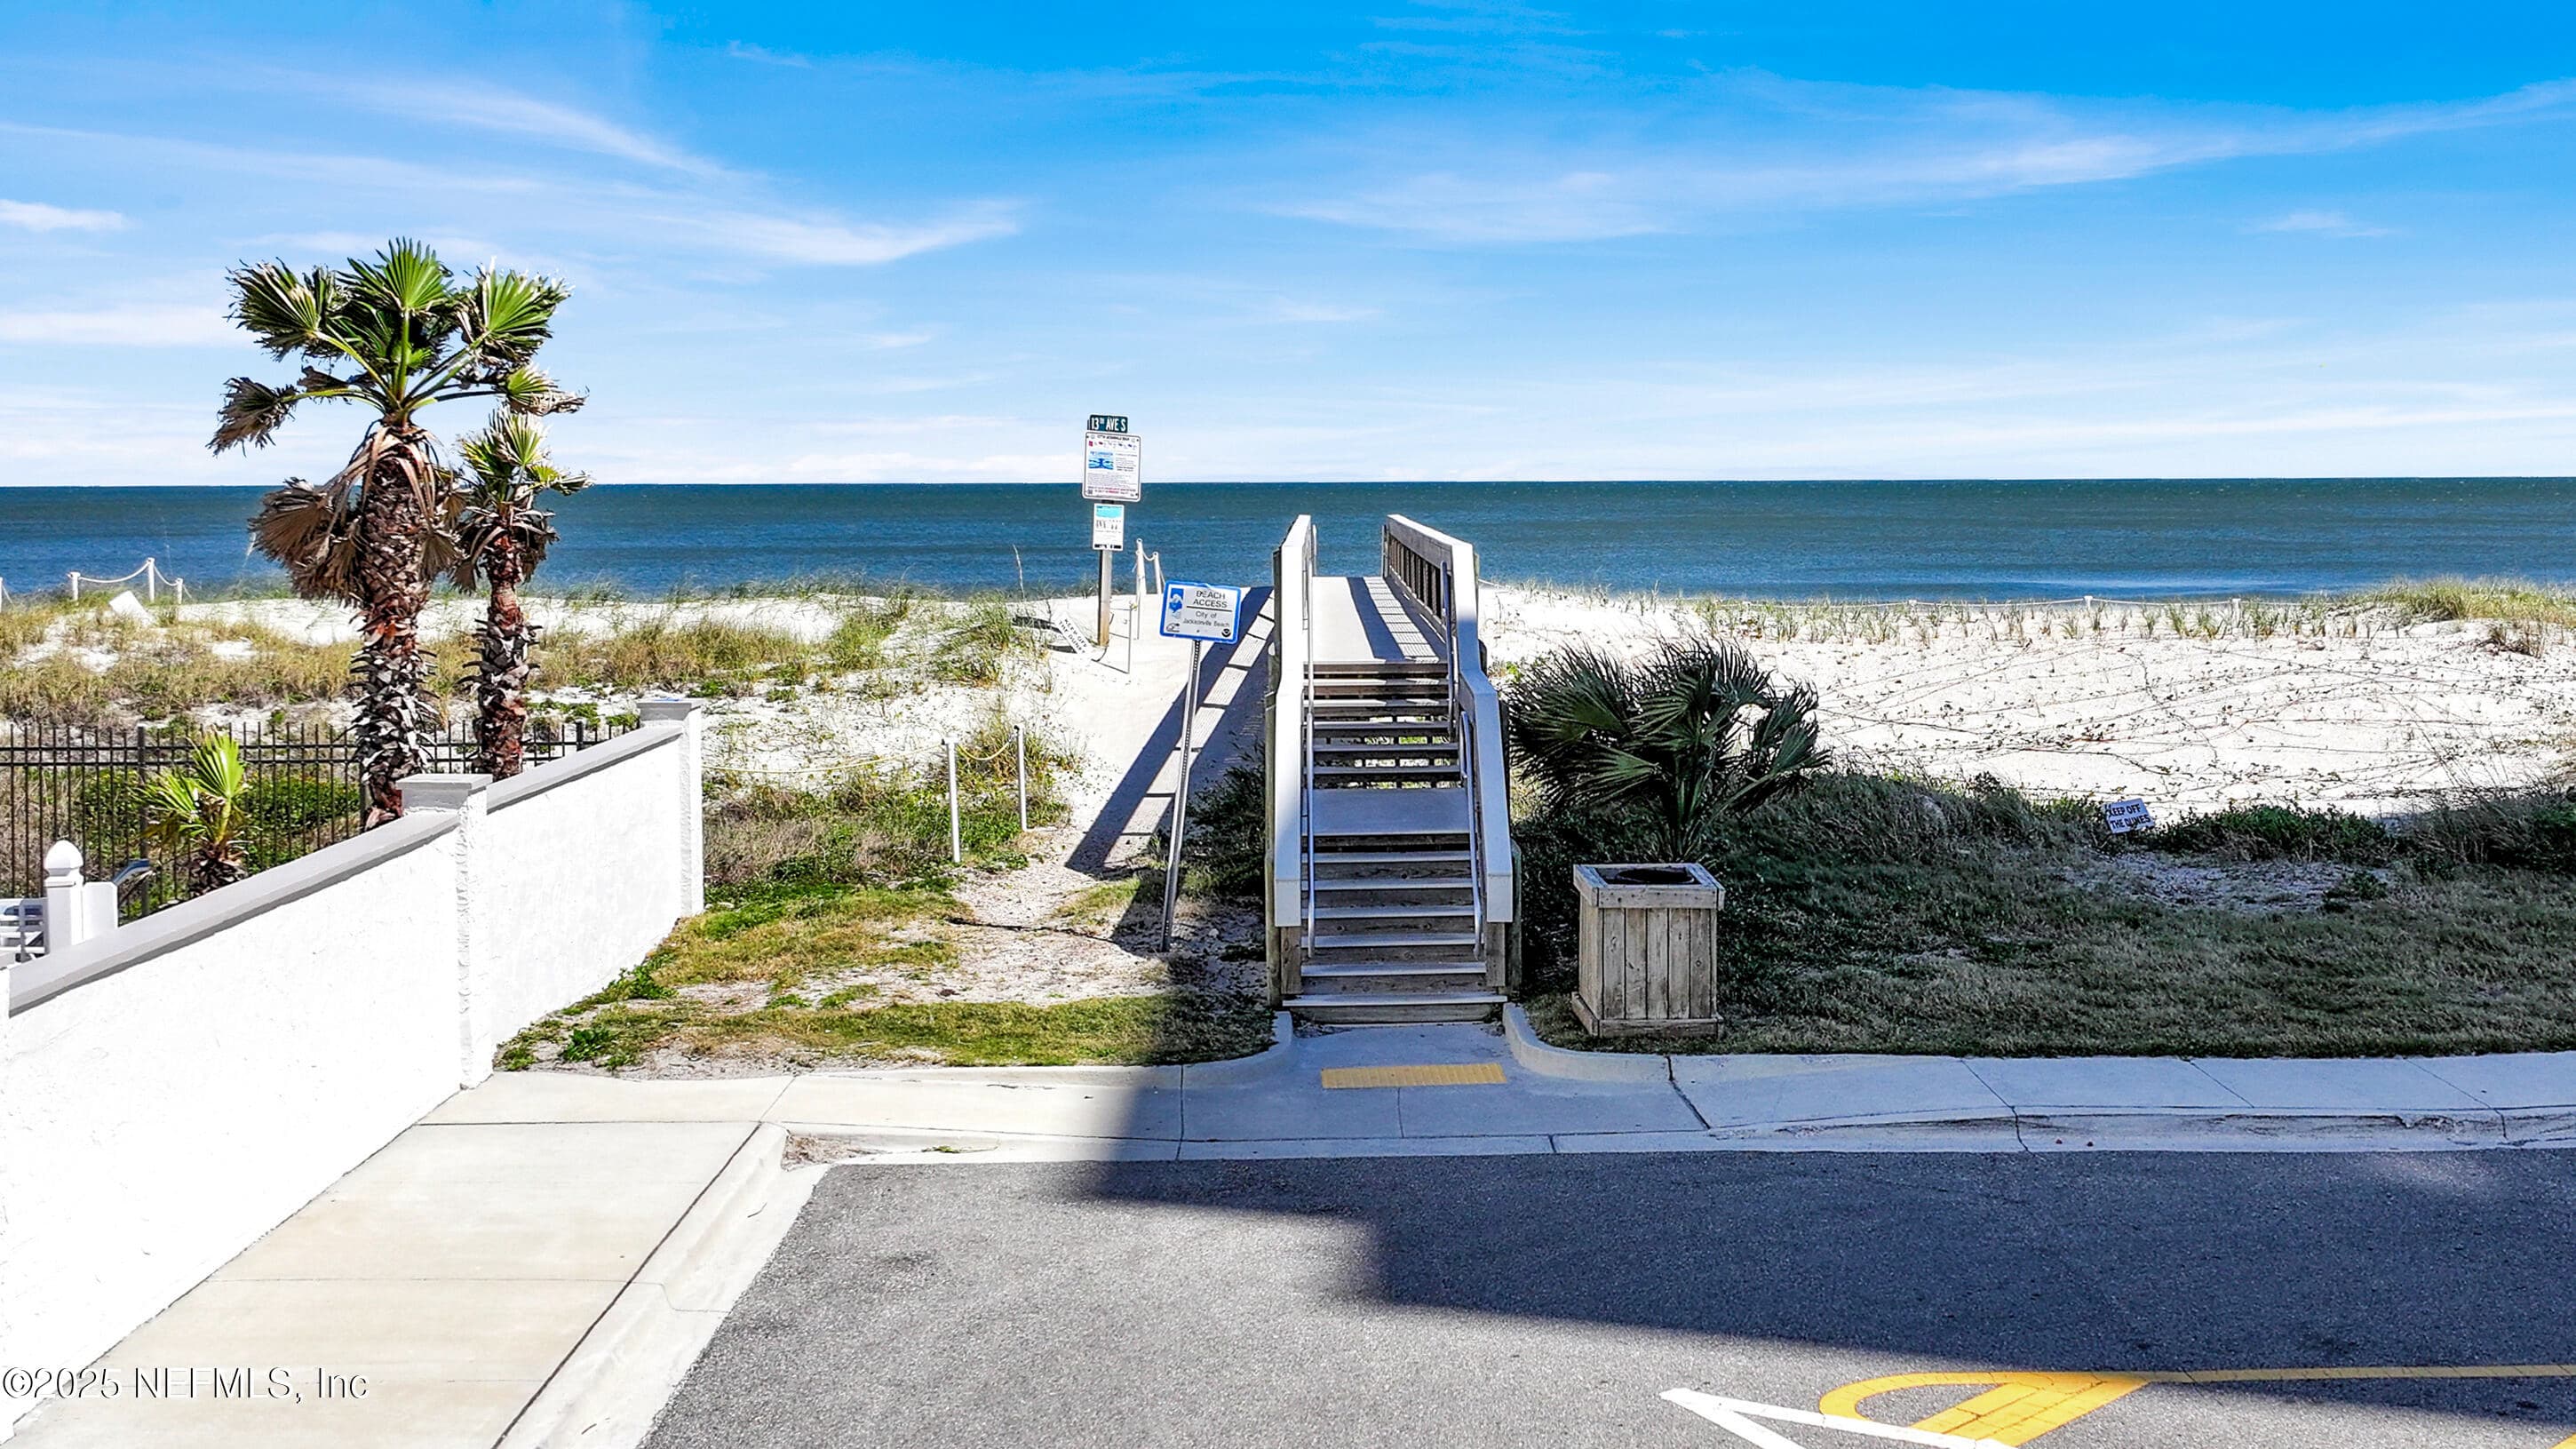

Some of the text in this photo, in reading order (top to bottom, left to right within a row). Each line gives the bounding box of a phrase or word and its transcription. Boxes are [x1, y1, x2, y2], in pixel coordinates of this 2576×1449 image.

[1106, 417, 1119, 432] AVE
[1120, 418, 1126, 433] S
[1196, 590, 1226, 600] BEACH
[1193, 599, 1228, 609] ACCESS
[2107, 803, 2141, 817] KEEP OFF
[2110, 818, 2125, 830] THE
